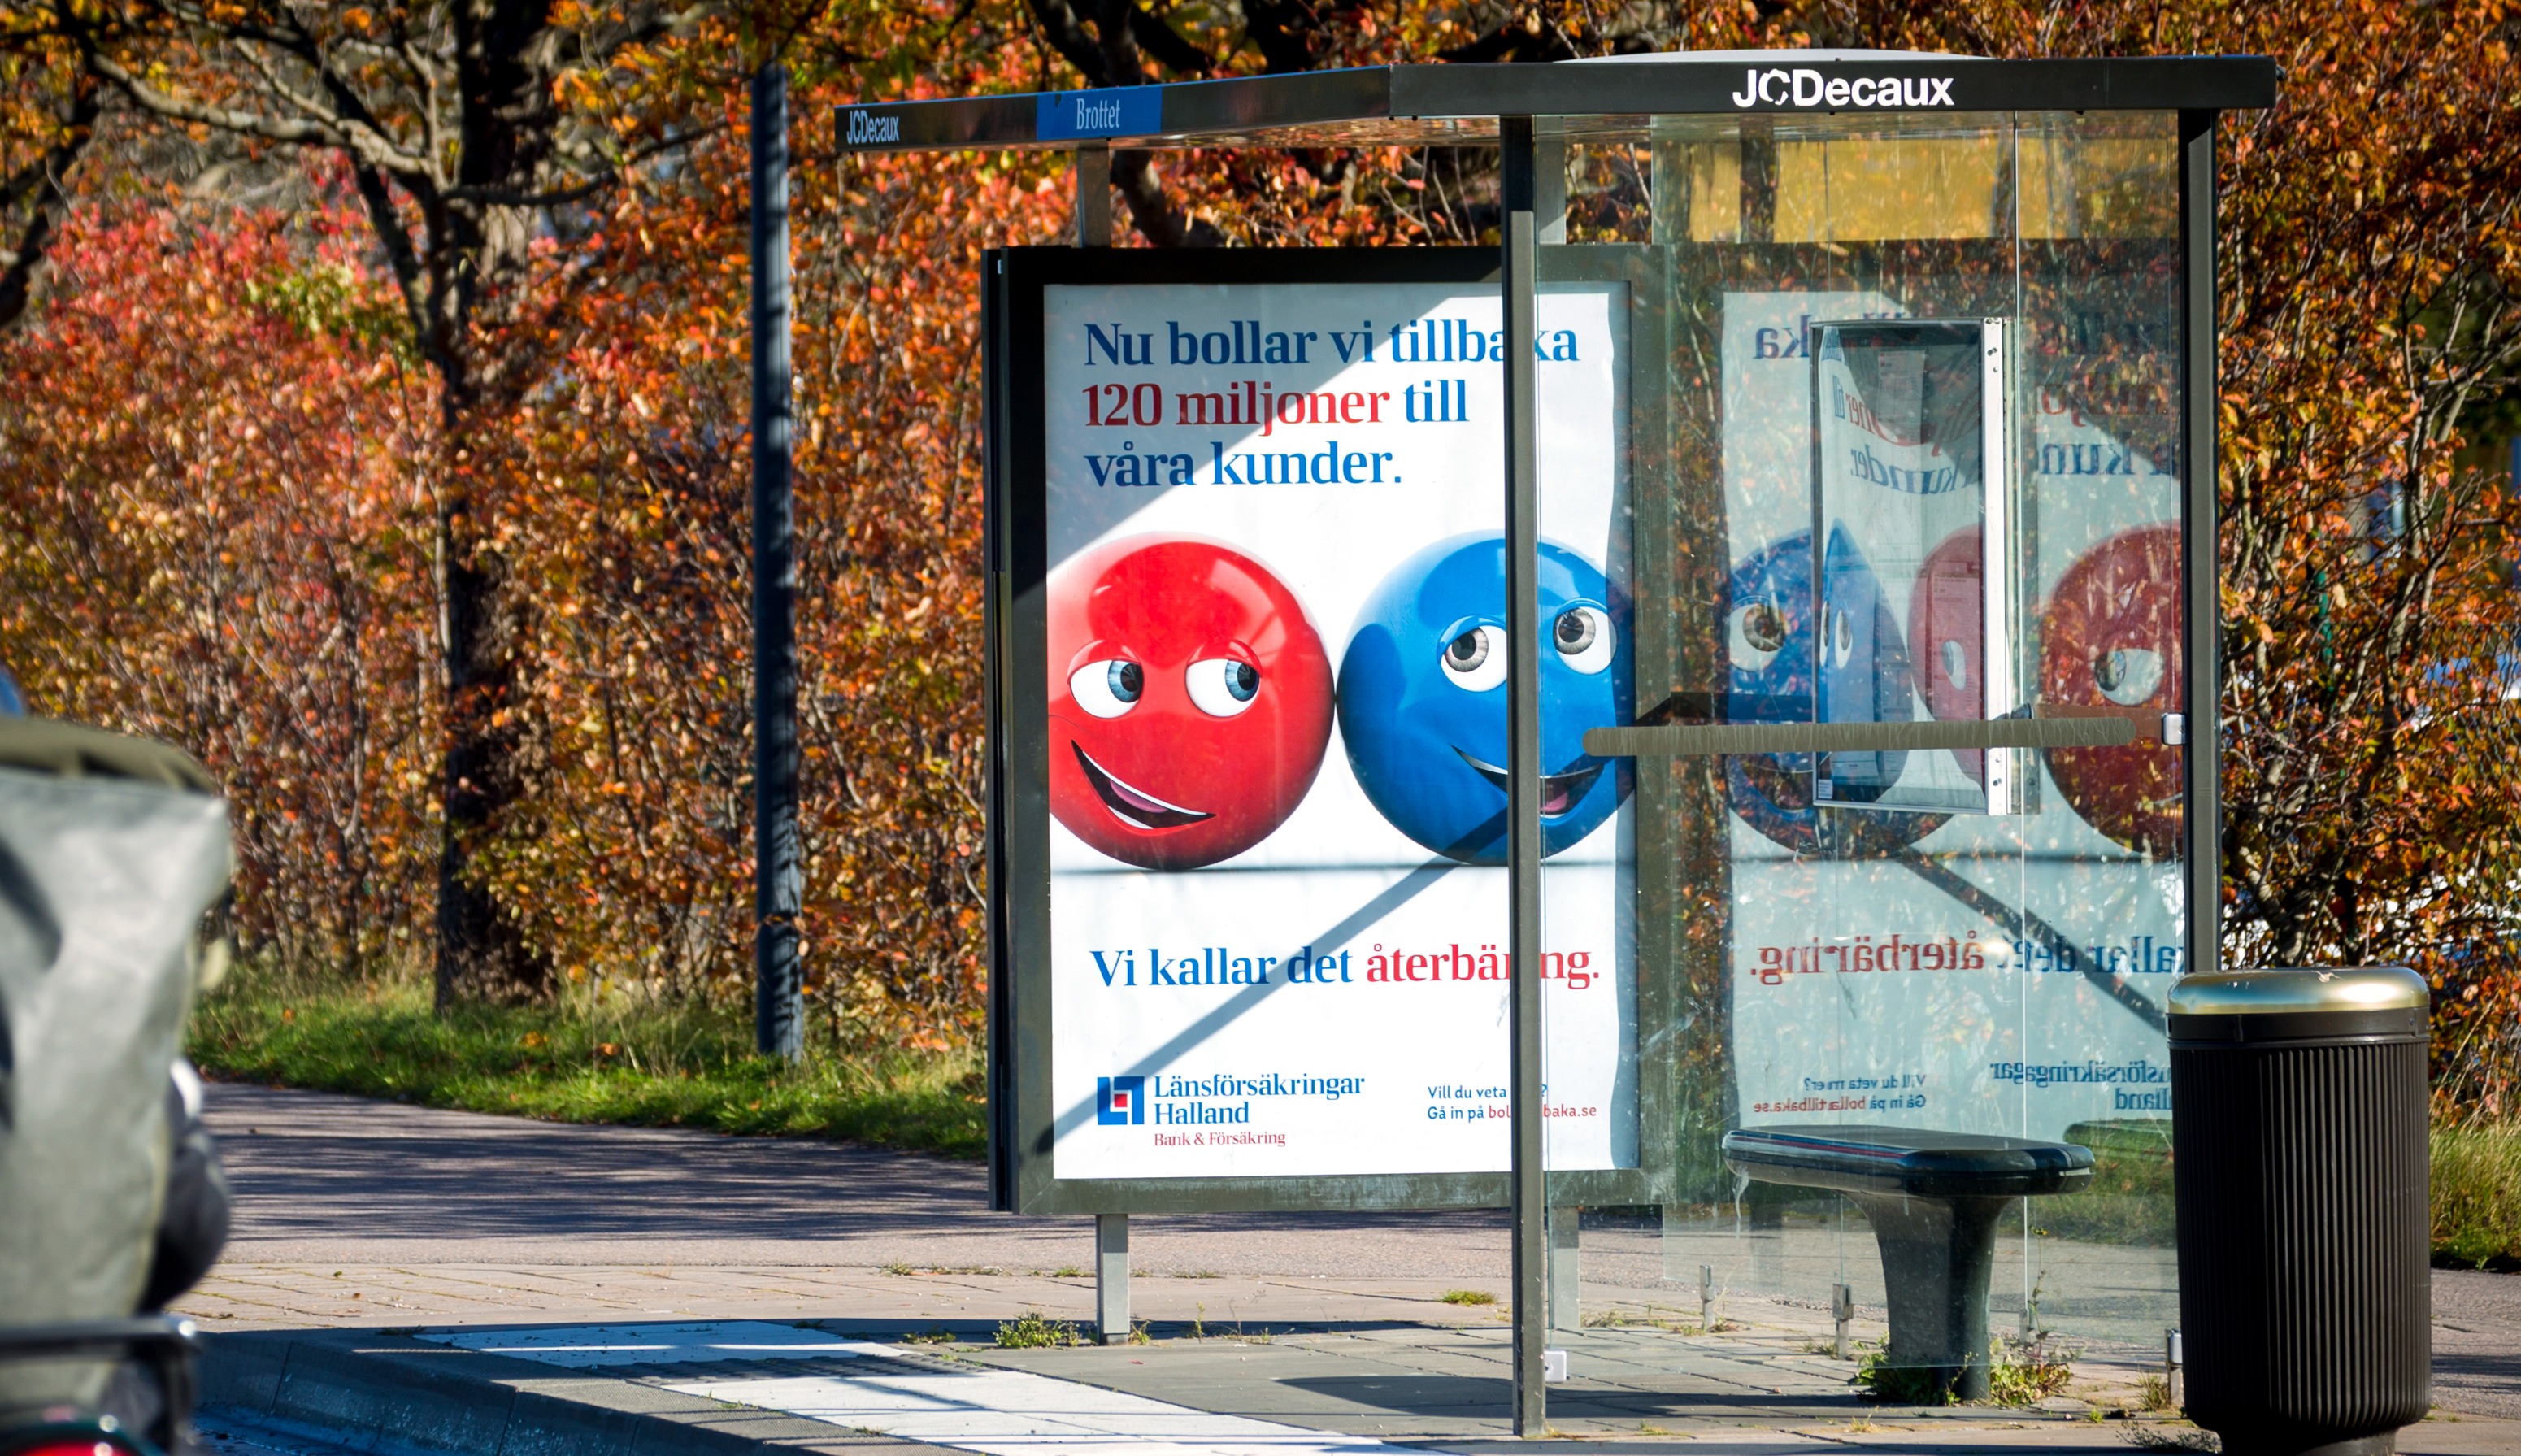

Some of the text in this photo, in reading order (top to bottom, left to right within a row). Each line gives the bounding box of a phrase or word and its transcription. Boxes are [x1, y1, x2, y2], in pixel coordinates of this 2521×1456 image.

[1732, 68, 1955, 108] JCDecaux
[846, 111, 900, 146] JCDecaux
[1076, 98, 1121, 131] Brottet
[1083, 323, 1154, 366] Nu
[1166, 321, 1318, 365] bollar
[1329, 319, 1376, 363] vi
[1082, 380, 1470, 437] 120 miljoner till
[1084, 441, 1402, 488] våra kunder.
[1089, 943, 1599, 989] Vi kallar det återbäng.
[1154, 1073, 1366, 1100] Länsförsäkringar
[1428, 1084, 1507, 1099] Vill du veta
[1154, 1102, 1250, 1125] Halland
[1428, 1105, 1446, 1119] Gå
[1450, 1106, 1463, 1119] in
[1467, 1105, 1484, 1123] på
[1154, 1131, 1287, 1148] Bank & Försäkring
